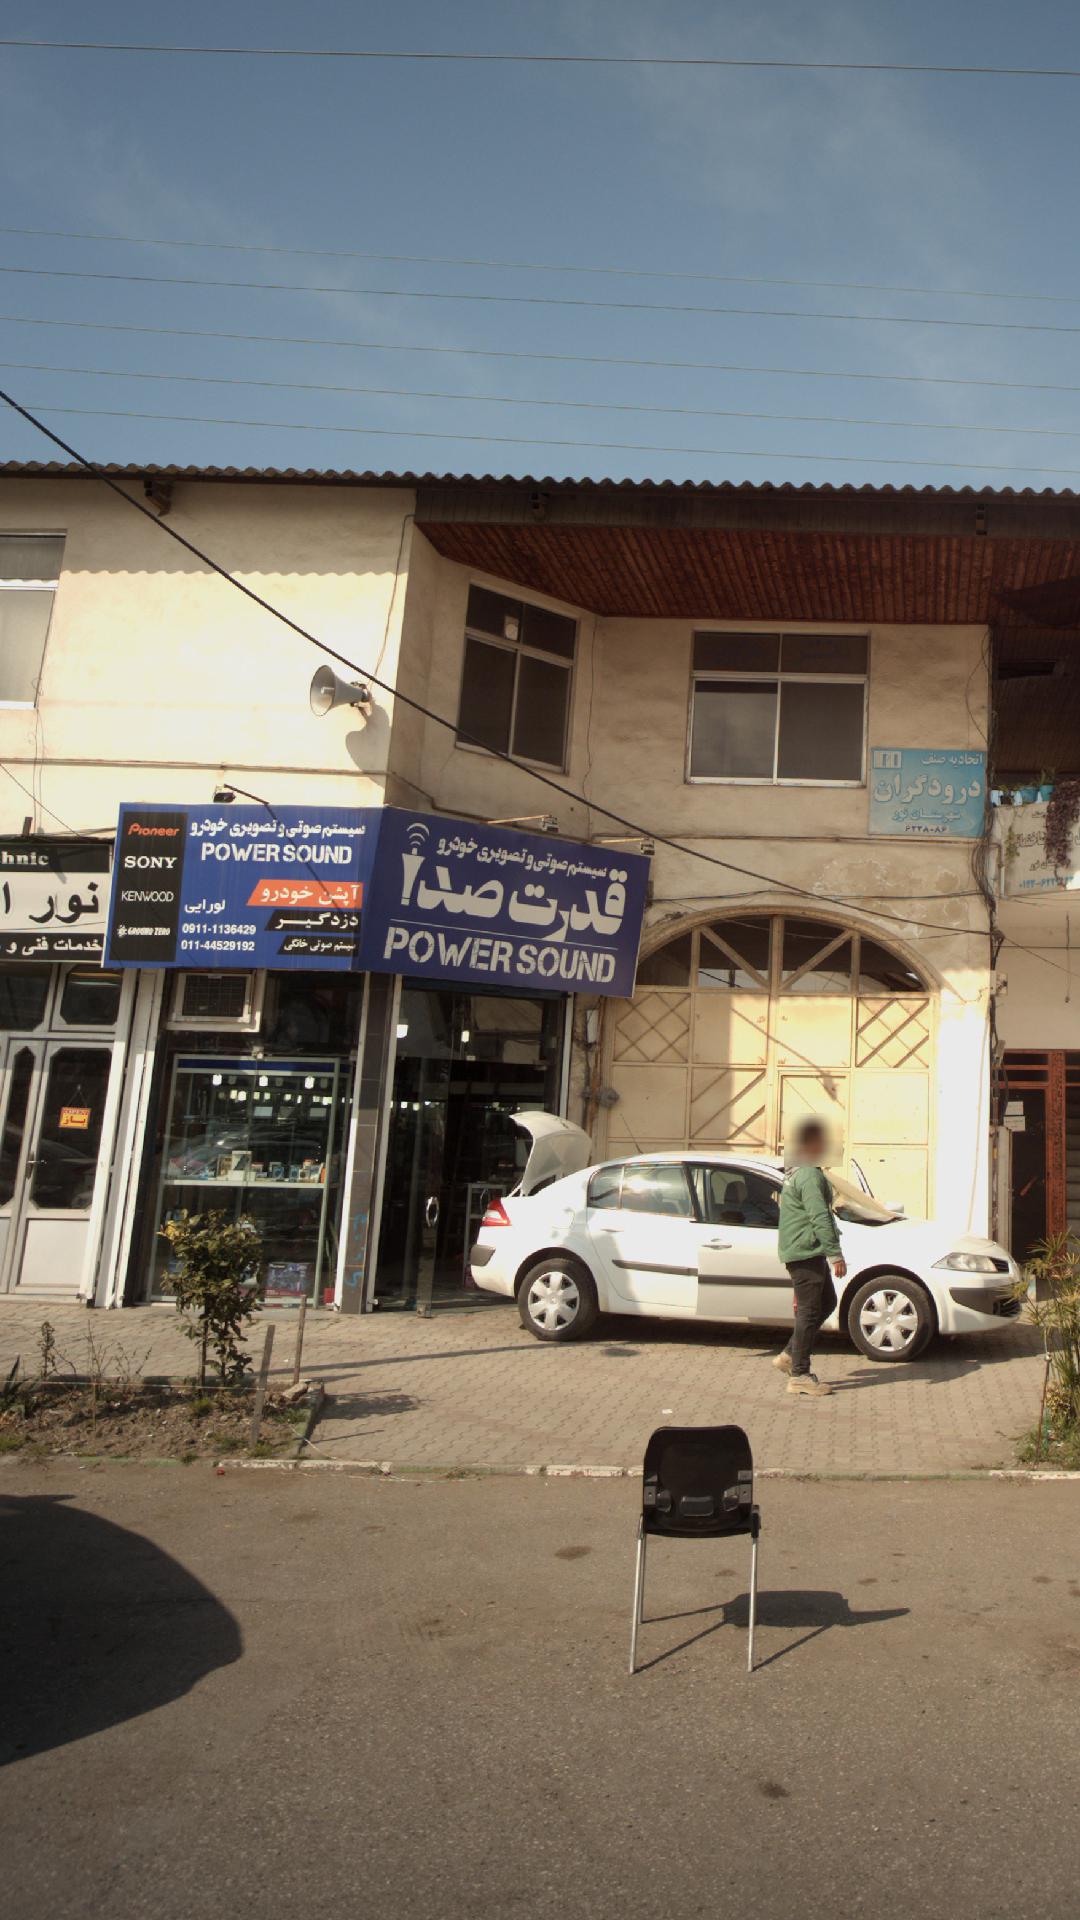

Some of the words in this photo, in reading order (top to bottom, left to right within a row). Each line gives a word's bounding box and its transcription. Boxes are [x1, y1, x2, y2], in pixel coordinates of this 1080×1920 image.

[874, 774, 981, 805] درودگران
[128, 823, 180, 837] Pioneer
[189, 818, 228, 837] خودرو
[201, 842, 280, 862] POWER
[282, 845, 352, 864] SOUND
[438, 837, 478, 859] خودرو
[124, 856, 178, 869] SONY
[401, 847, 505, 919] صدا
[28, 881, 99, 924] نور
[121, 890, 174, 903] KENWOOD
[260, 885, 314, 904] خودرو
[318, 885, 360, 905] آپشن
[508, 869, 628, 943] قدرت
[182, 924, 257, 935] 0911-1136429
[5, 941, 17, 954] و
[21, 936, 49, 956] فنی
[53, 938, 103, 951] خدمات
[181, 940, 255, 952] 011-44529192
[383, 926, 512, 974] POWER
[516, 944, 616, 983] SOUND
